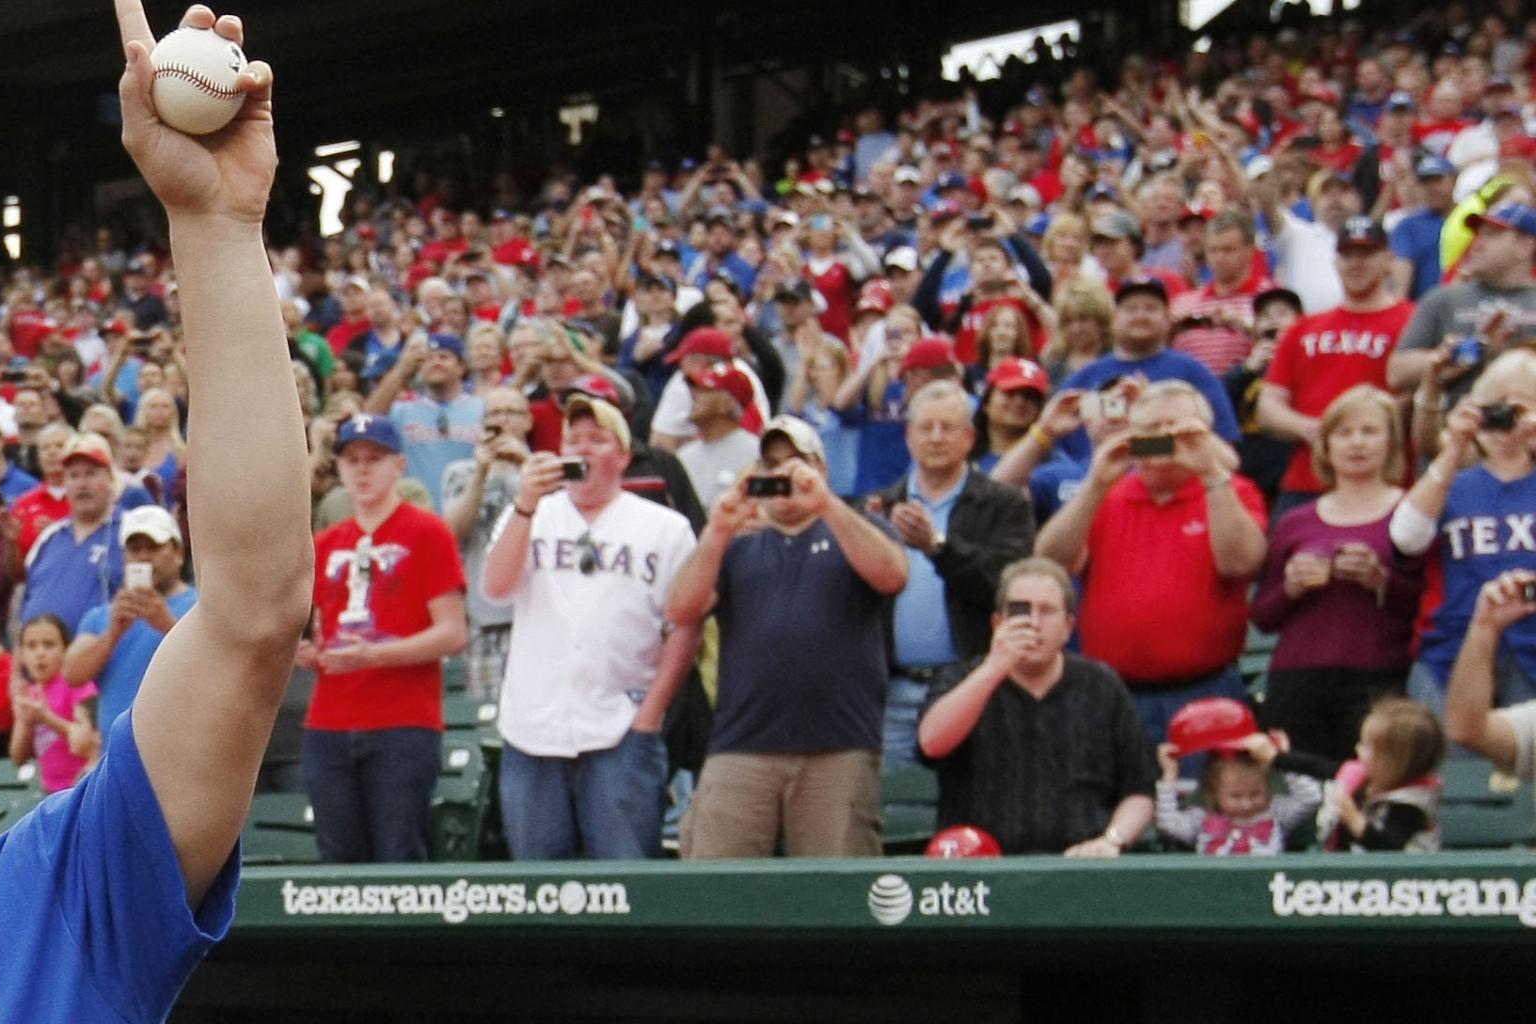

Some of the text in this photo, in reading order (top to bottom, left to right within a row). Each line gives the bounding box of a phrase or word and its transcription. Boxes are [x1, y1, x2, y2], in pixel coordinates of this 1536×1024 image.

[1301, 331, 1389, 359] TEXAS
[352, 412, 374, 434] T
[1443, 514, 1536, 560] TEX
[282, 879, 631, 924] texasrangers.com
[918, 880, 991, 916] at&t
